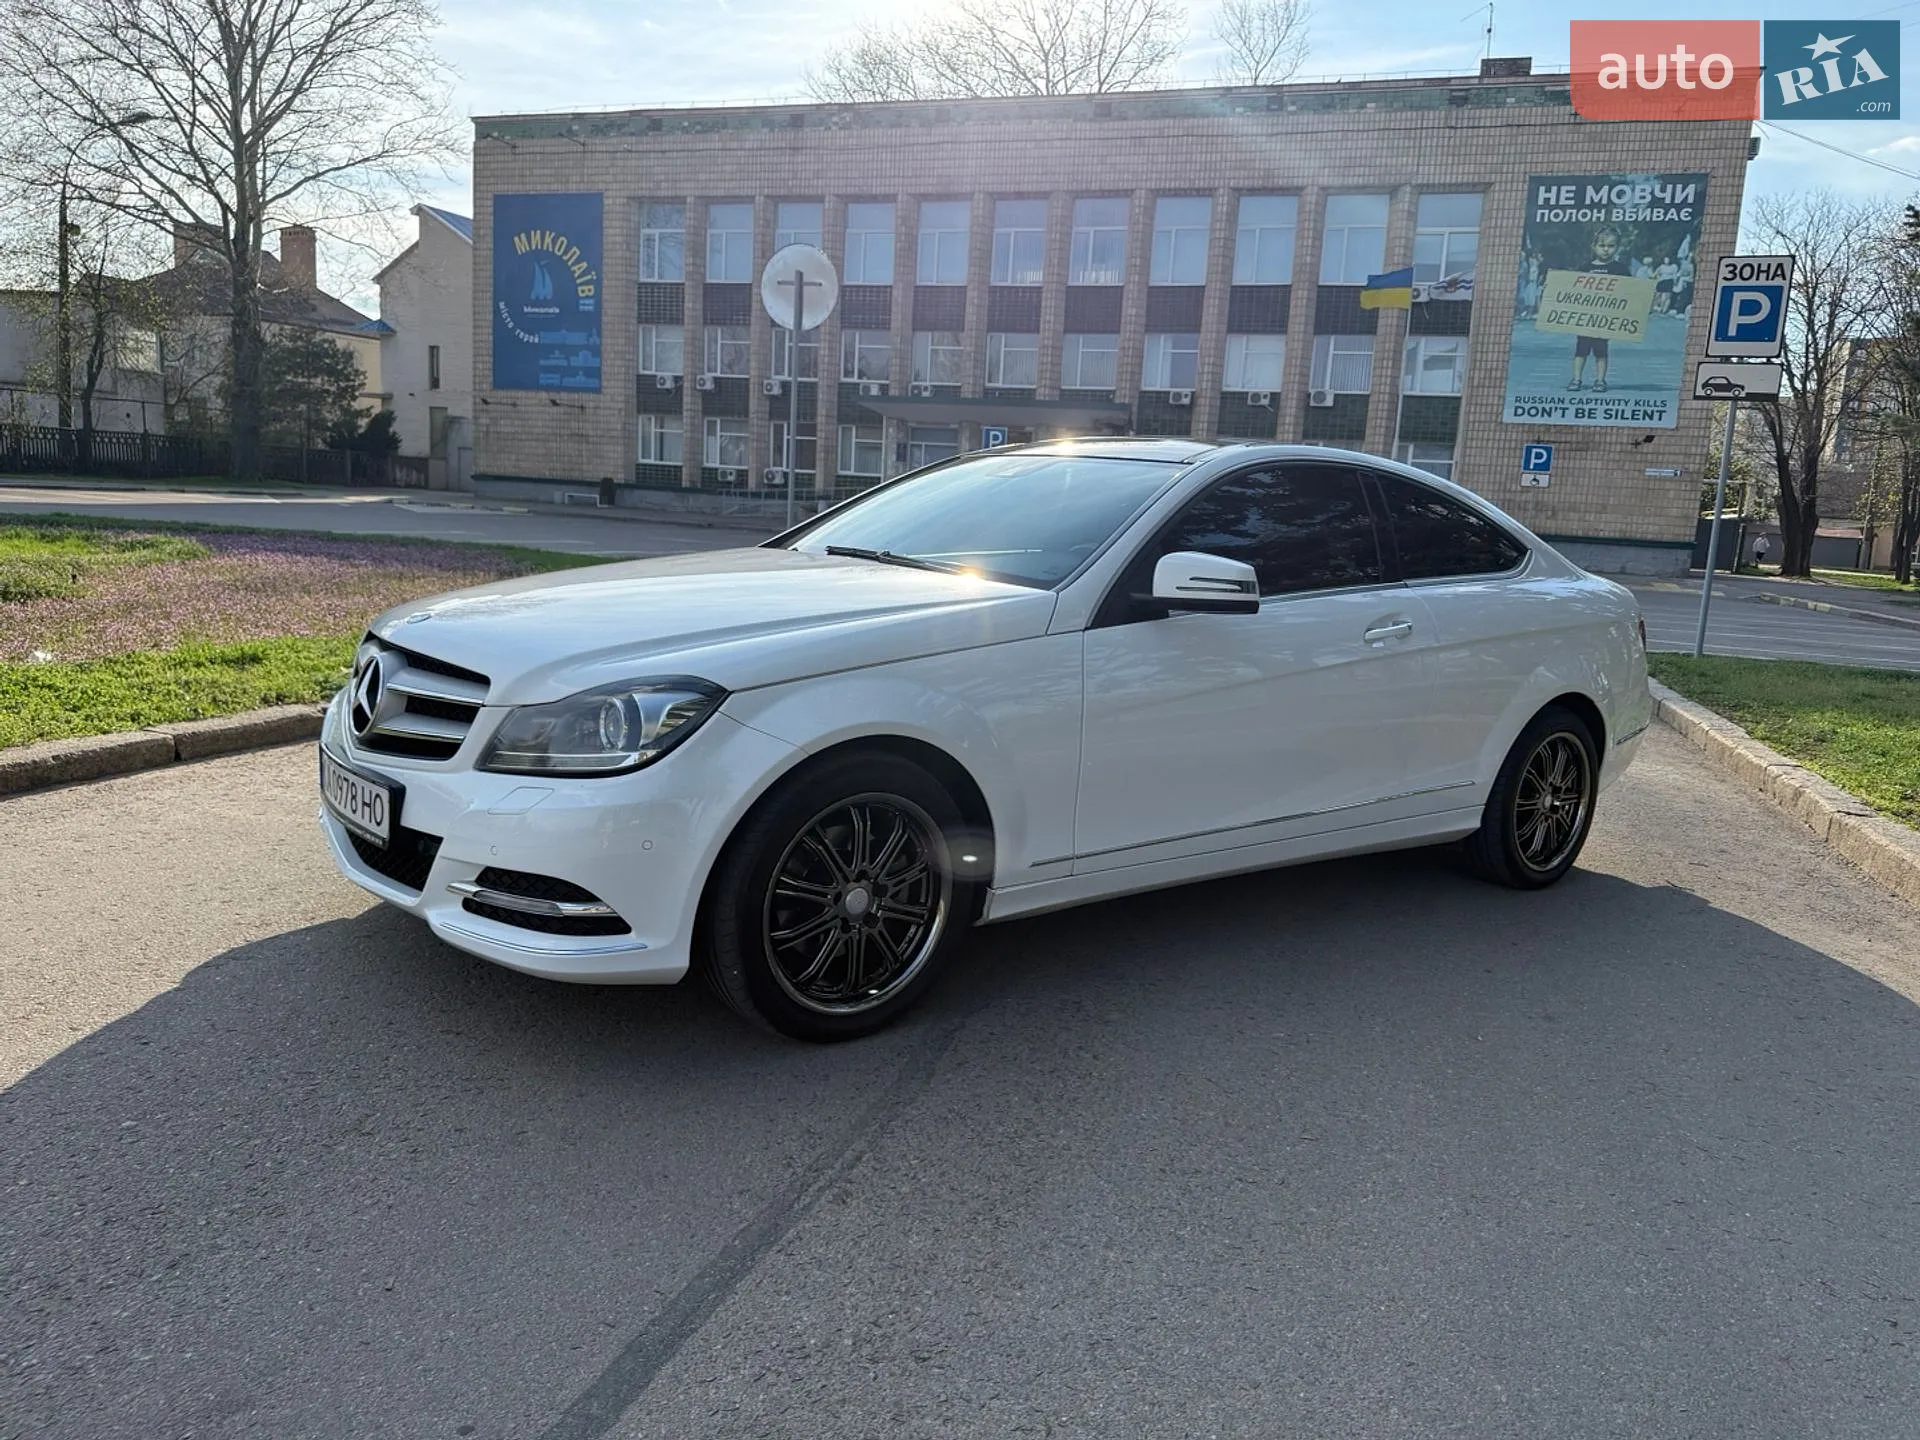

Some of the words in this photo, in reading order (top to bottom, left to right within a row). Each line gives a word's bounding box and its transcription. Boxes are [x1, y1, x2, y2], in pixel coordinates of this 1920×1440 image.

[1537, 185, 1576, 205] НЕ
[1585, 183, 1696, 206] МОВЧИ
[1536, 208, 1606, 222] ПОЛОН
[1611, 207, 1693, 222] ВБИВАЄ
[512, 230, 597, 298] МИКОЛАЇВ
[1722, 262, 1787, 282] ЗОНА
[1572, 276, 1619, 292] FREE
[1546, 309, 1640, 335] DEFENDERS
[1728, 291, 1771, 337] P
[1514, 396, 1566, 405] RUSSIAN
[1569, 397, 1631, 407] CAPTIVITY
[1634, 399, 1668, 408] KILLS
[1513, 406, 1569, 419] DON'T
[1574, 408, 1598, 420] BE
[1603, 408, 1667, 421] SILENT
[361, 785, 384, 827] HO
